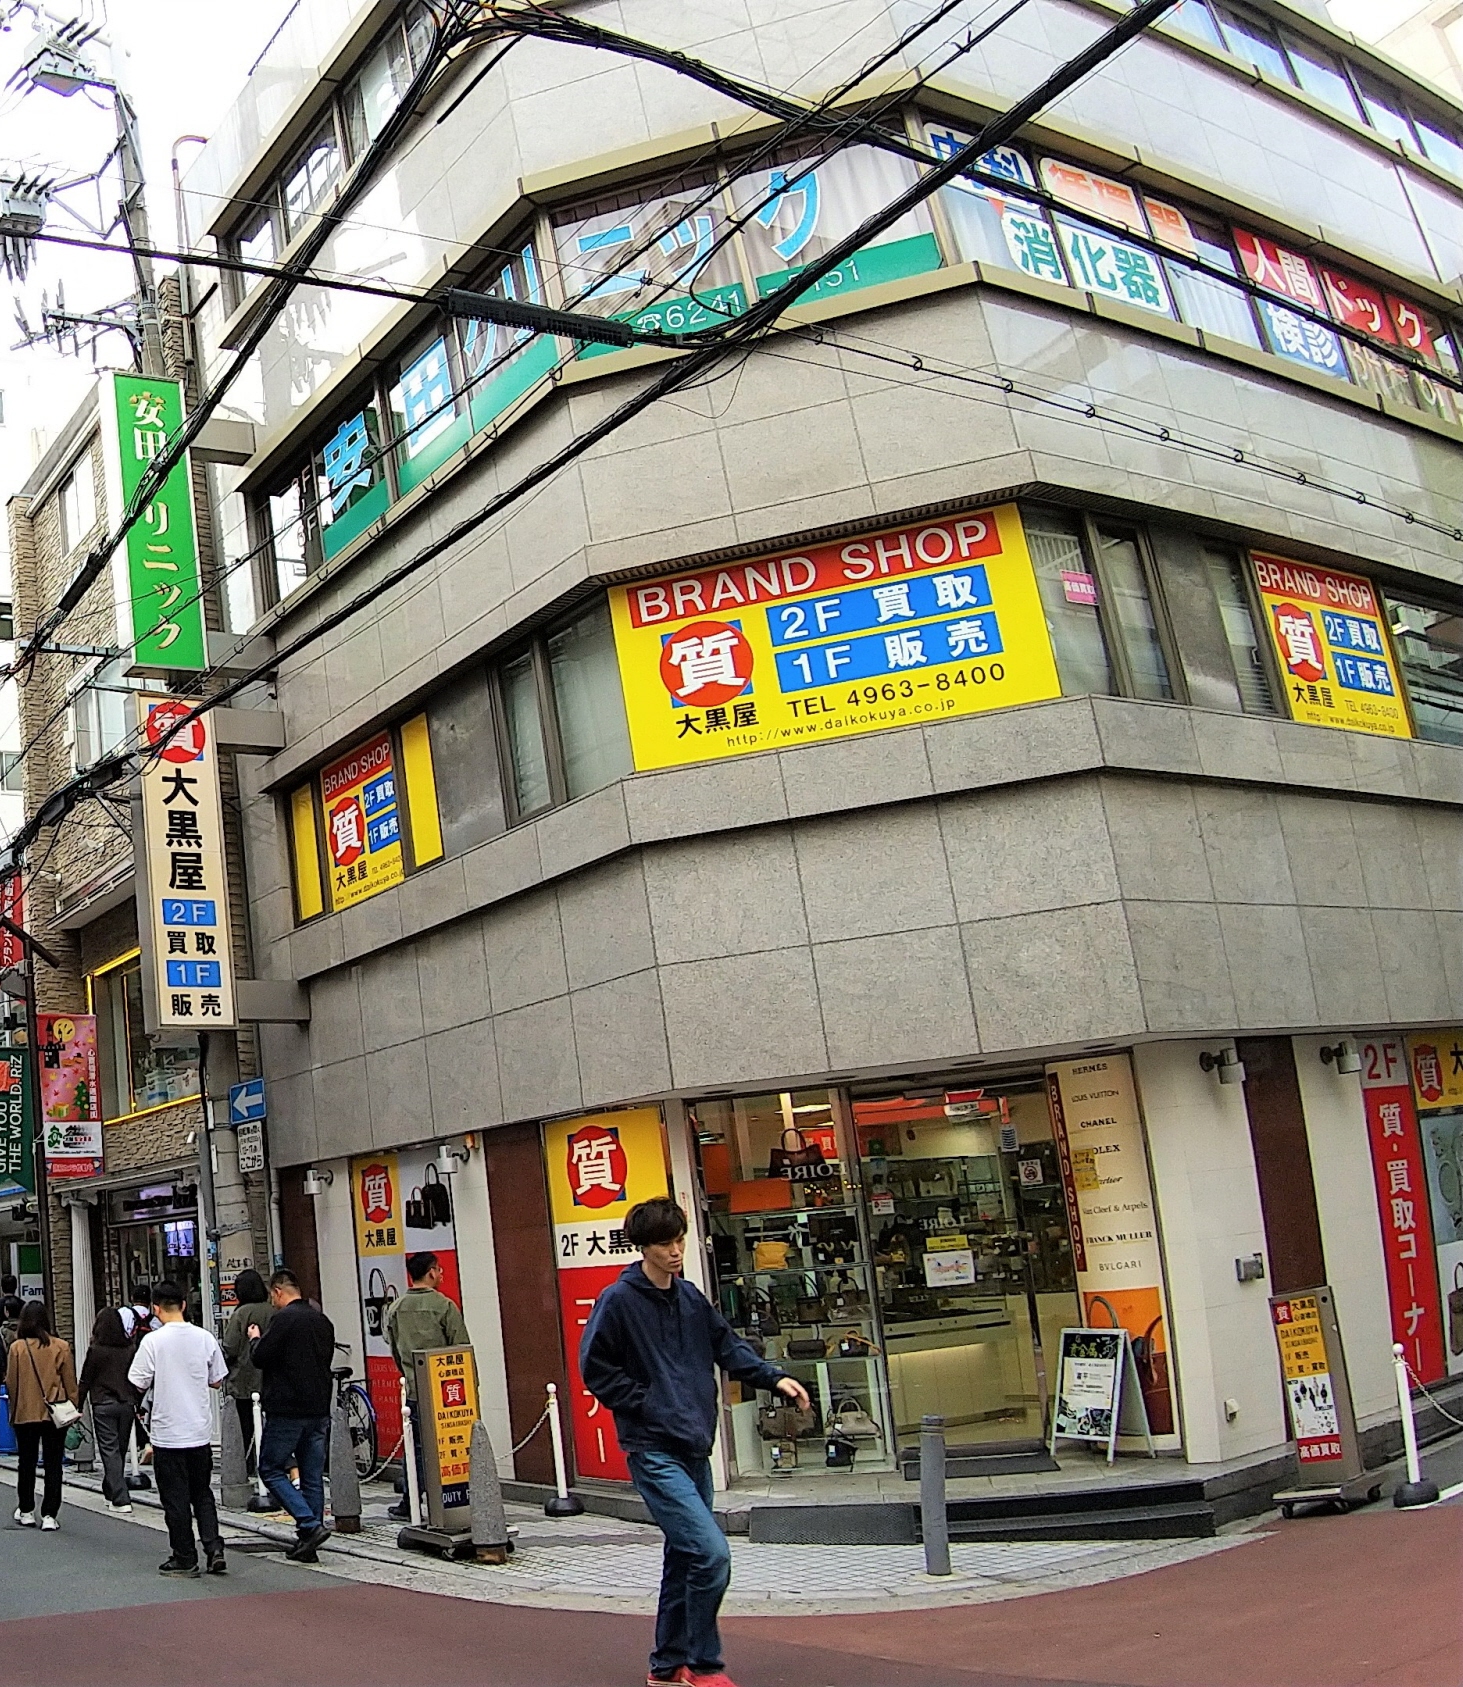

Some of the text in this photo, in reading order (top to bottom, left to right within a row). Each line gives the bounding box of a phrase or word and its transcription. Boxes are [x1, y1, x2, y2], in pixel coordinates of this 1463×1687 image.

[1011, 218, 1160, 307] 消化器
[1252, 234, 1424, 349] 人間ドック
[1272, 303, 1339, 368] 検診
[130, 391, 183, 650] 安田リニック
[637, 520, 988, 623] BRAND SHOP
[1255, 560, 1371, 611] BRAND SHOP
[780, 574, 978, 640] 2F 買取
[1279, 615, 1323, 672] 質
[1325, 615, 1381, 652] 2F 買取
[669, 632, 746, 697] 質
[793, 619, 989, 684] 1F 販売
[787, 664, 1006, 719] TEL 4963-8400
[1335, 657, 1391, 692] 1F 販売
[1293, 683, 1335, 709] 大黒屋
[153, 712, 199, 755] 質
[676, 703, 759, 738] 大黒屋
[727, 698, 956, 748] http://www.daikokuya.co.jp
[324, 742, 390, 795] BRAND SHOP
[364, 780, 395, 809] 2F 買取
[162, 767, 207, 891] 大黒屋
[332, 804, 361, 858] 質
[369, 817, 399, 845] 1F 販売
[336, 861, 369, 891] 大黒屋
[172, 903, 207, 922] 2F
[167, 931, 216, 955] 買取
[177, 964, 211, 984] 1F
[171, 993, 221, 1017] 販売
[1362, 1044, 1398, 1080] 2F
[1417, 1053, 1441, 1092] 質
[10, 1081, 22, 1139] WORLD.
[1080, 1117, 1117, 1128] CHANEL
[1050, 1085, 1071, 1176] BRAND
[9, 1143, 22, 1173] THE
[240, 1154, 262, 1170] ここから
[571, 1135, 622, 1197] 質
[1091, 1144, 1121, 1155] OLEX
[364, 1173, 390, 1215] 質
[1095, 1174, 1123, 1186] artier
[1067, 1187, 1082, 1259] SHOP
[1093, 1204, 1112, 1214] Cleef
[1113, 1203, 1120, 1212] &
[1122, 1201, 1149, 1213] Arpels
[364, 1227, 398, 1248] 大黒屋
[561, 1233, 579, 1257] 2F
[1378, 1103, 1426, 1372] 質・買取コーナー
[1099, 1260, 1142, 1272] BVLGARI
[1277, 1305, 1289, 1321] 質
[1292, 1298, 1316, 1311] 大黒屋
[1280, 1324, 1319, 1339] DAIKOKUYA
[436, 1353, 465, 1367] 大黒屋
[446, 1383, 461, 1403] 質
[437, 1408, 474, 1421] DAIKOKUYA
[1300, 1442, 1342, 1460] 高価買取
[443, 1490, 462, 1504] DUTY
